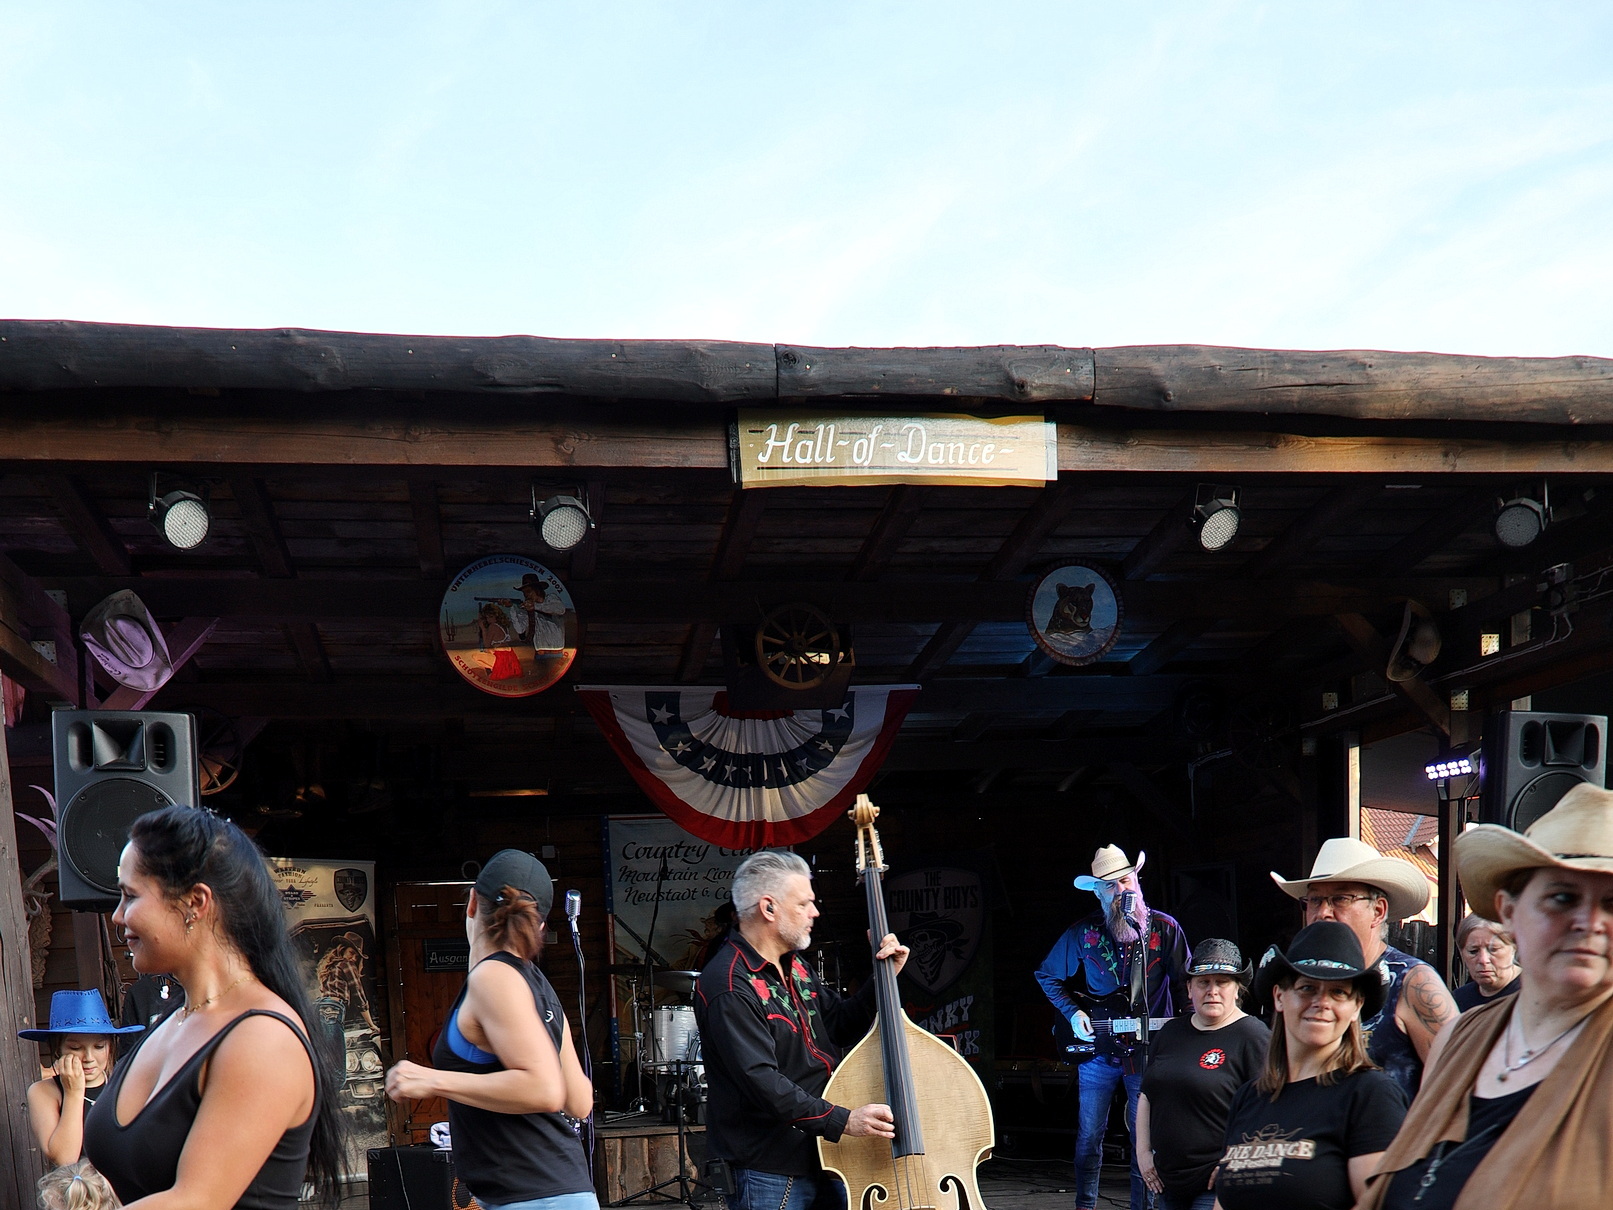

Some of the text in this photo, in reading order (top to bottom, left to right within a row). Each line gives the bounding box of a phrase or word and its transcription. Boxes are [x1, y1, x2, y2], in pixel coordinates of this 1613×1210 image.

[451, 557, 563, 594] UNTERHEBELSCHIESSEN 2002
[622, 841, 710, 864] Country
[618, 866, 698, 884] Moutain
[924, 871, 941, 886] THE
[625, 886, 698, 905] Neustadt
[889, 885, 978, 913] COUNTY BOYS
[429, 951, 468, 965] Ausgan
[1251, 1140, 1316, 1159] DANCE
